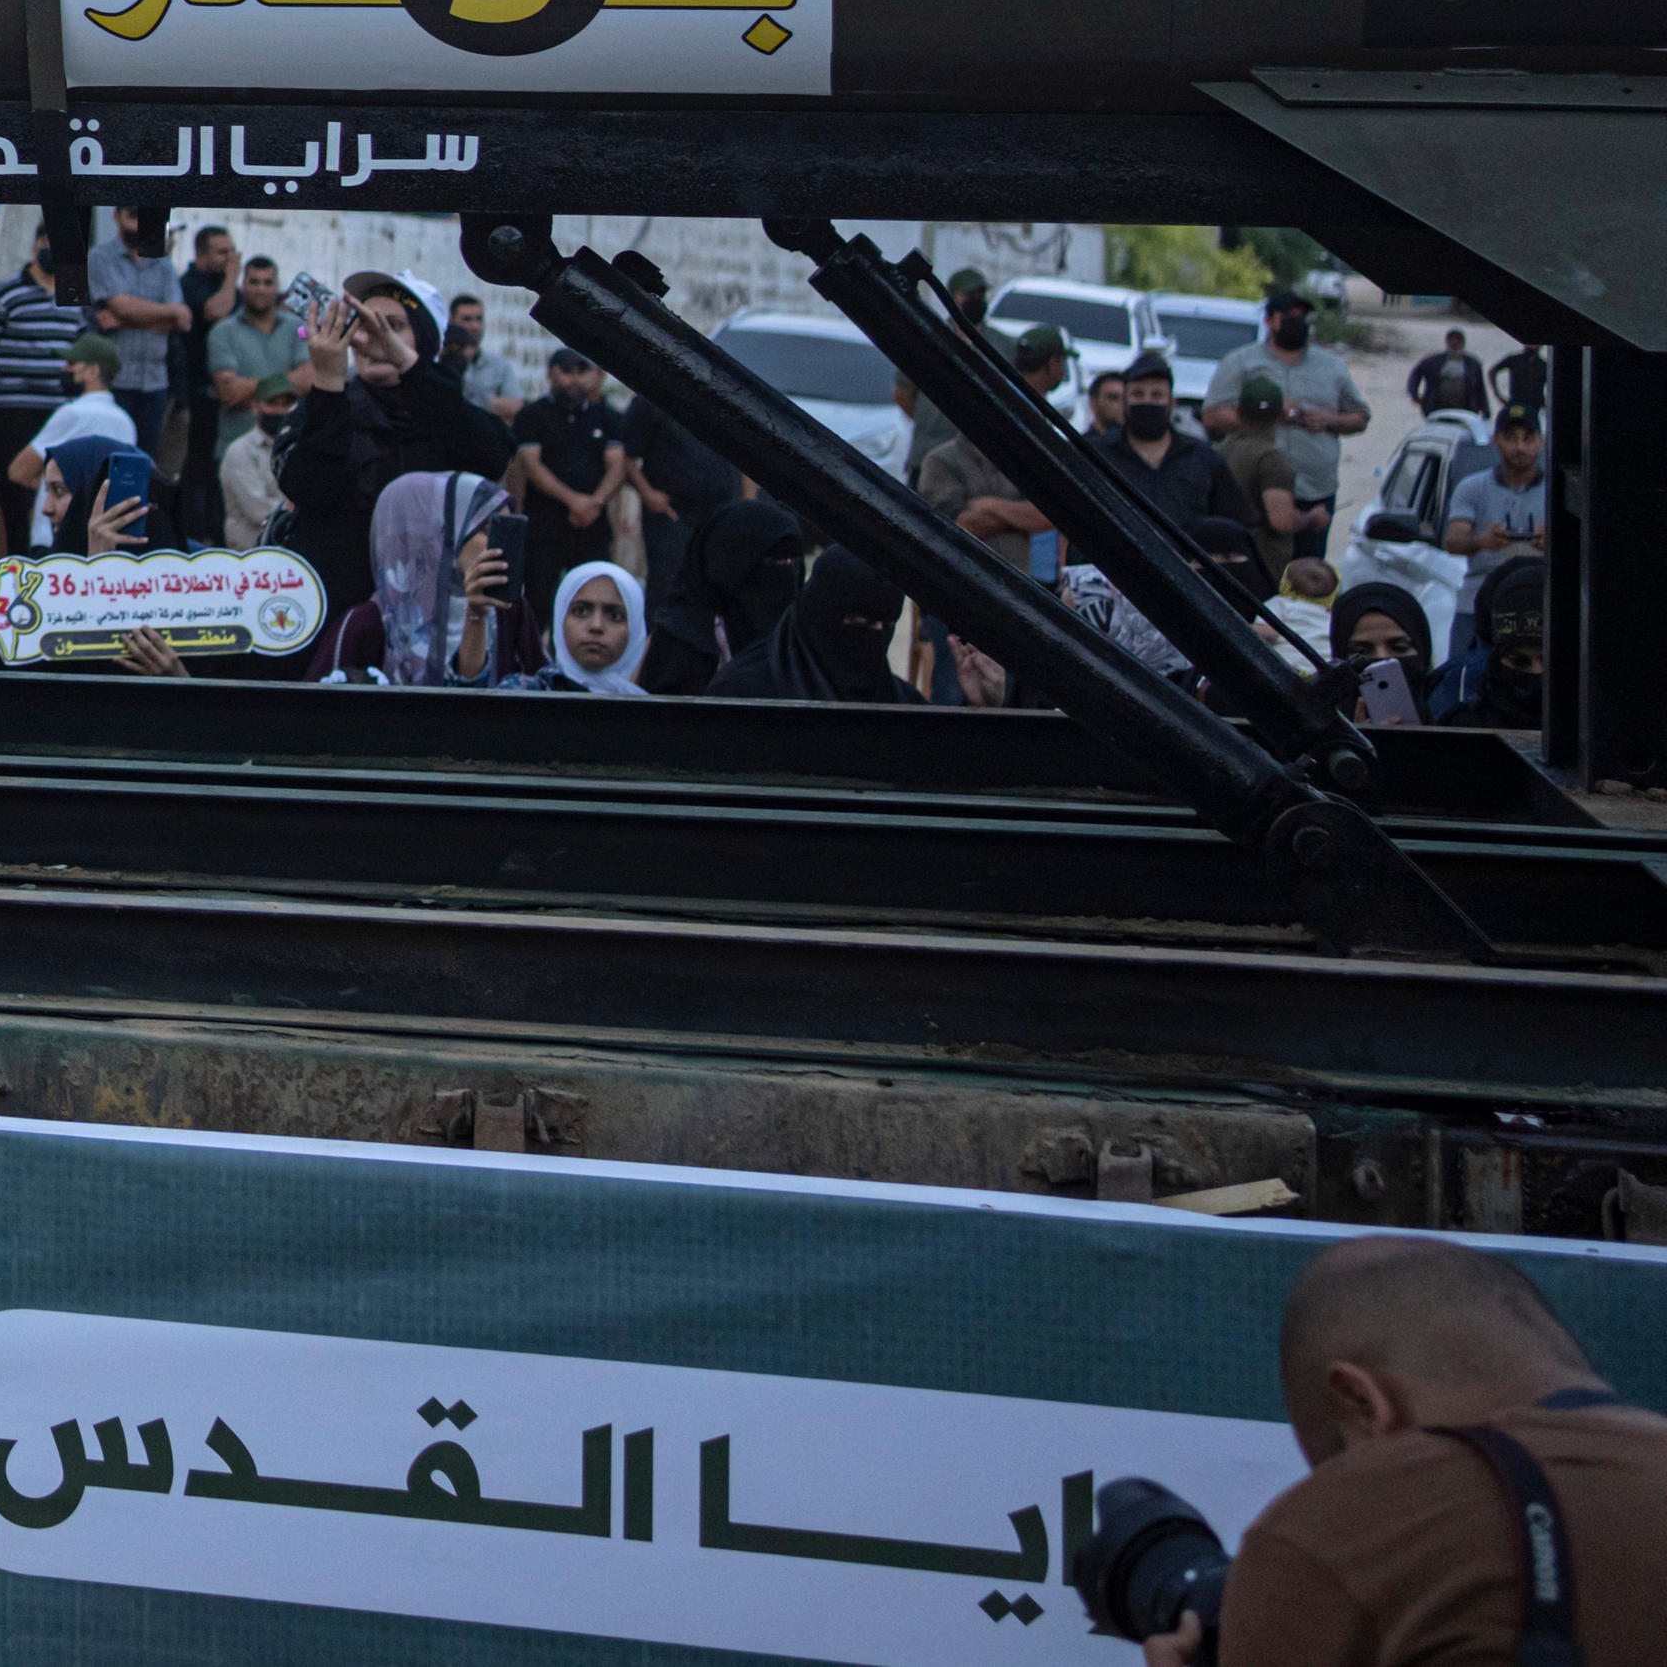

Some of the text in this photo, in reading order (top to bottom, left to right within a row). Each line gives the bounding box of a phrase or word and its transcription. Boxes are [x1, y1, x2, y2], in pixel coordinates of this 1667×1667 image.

[230, 121, 479, 195] سرايا
[47, 573, 77, 596] 36
[99, 576, 160, 602] الجهادية
[161, 573, 230, 595] الانطلاقة
[234, 571, 250, 600] في
[251, 569, 304, 594] مشاركة
[161, 629, 237, 648] منطقة
[699, 1433, 1095, 1627] ايا
